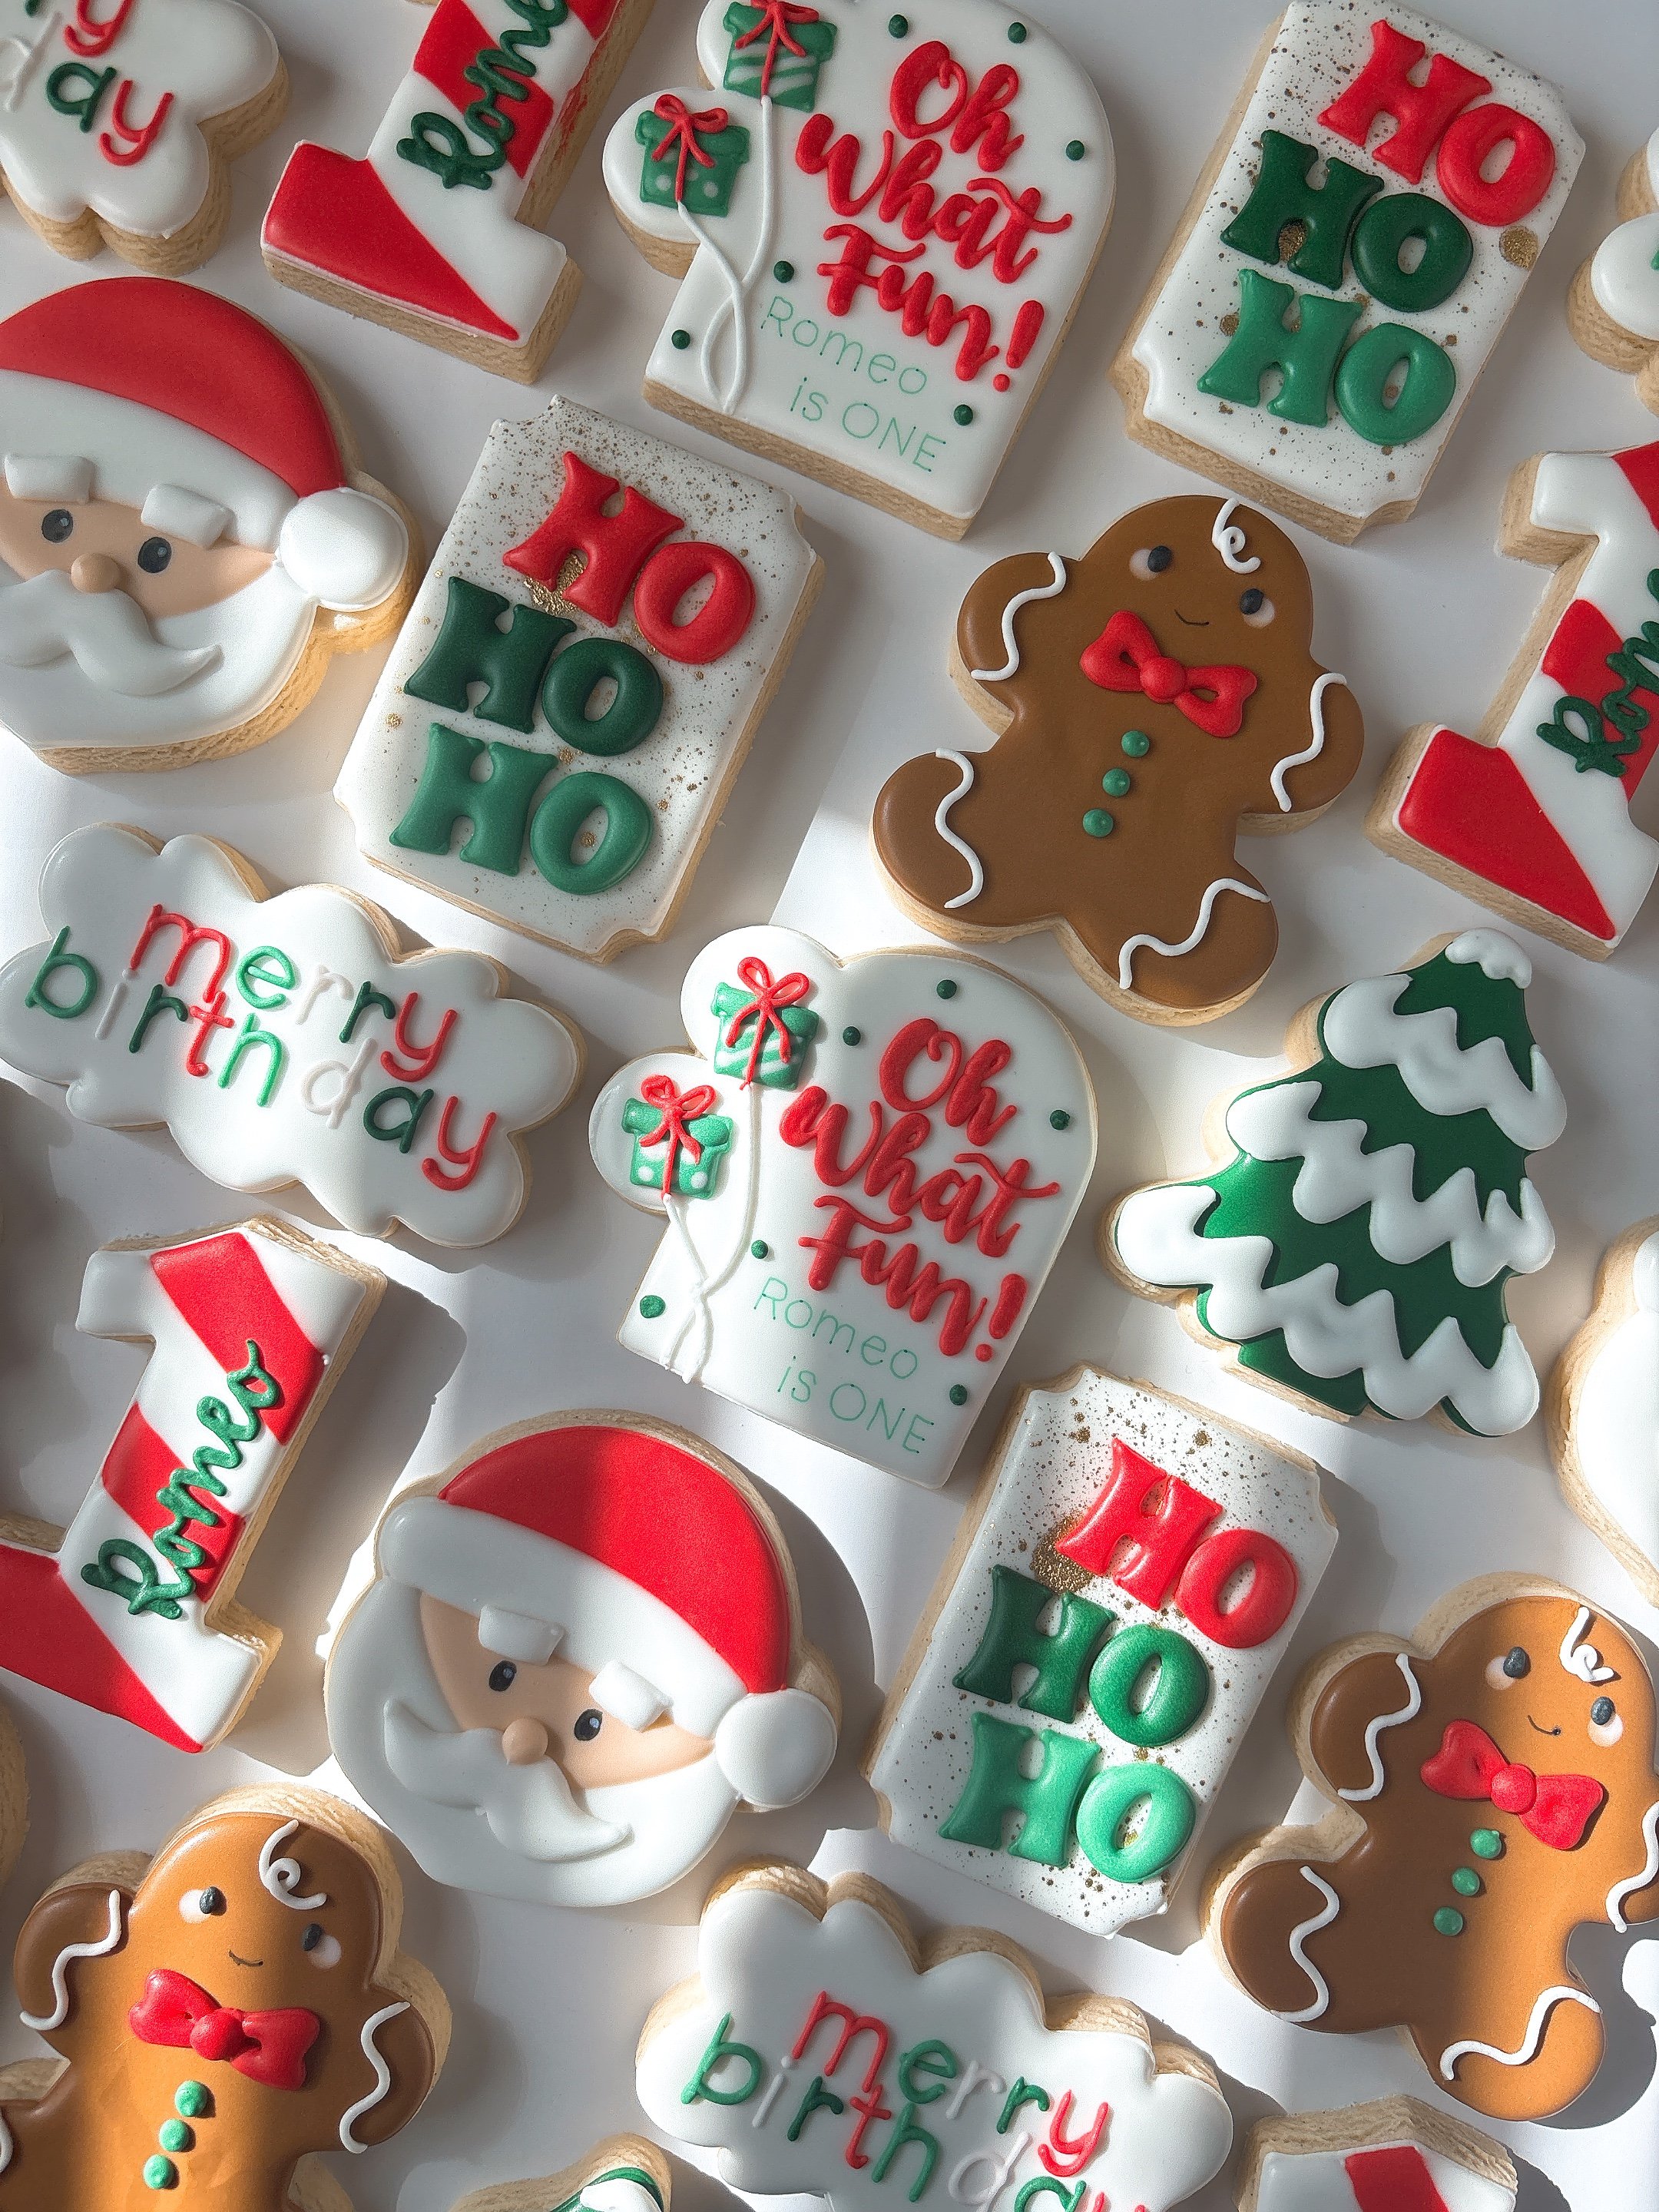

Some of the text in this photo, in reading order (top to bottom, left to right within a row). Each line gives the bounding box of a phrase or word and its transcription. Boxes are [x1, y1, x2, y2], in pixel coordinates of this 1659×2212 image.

[889, 41, 1025, 172] Oh
[1317, 19, 1557, 227] HO
[796, 114, 1073, 283] What
[1219, 129, 1474, 313] HO
[760, 295, 927, 395] Romeo
[817, 224, 1045, 392] Fun!
[1197, 269, 1457, 446] HO
[789, 376, 947, 473] is ONE
[502, 451, 757, 665] HO
[404, 576, 665, 757] HO
[389, 722, 654, 896] HO
[130, 903, 458, 1083] merry
[879, 1018, 1018, 1147] Oh
[779, 1085, 1061, 1258] What
[753, 1277, 919, 1380] Romeo
[798, 1195, 1028, 1363] Fun!
[777, 1355, 935, 1454] is ONE
[1055, 1436, 1299, 1649] HO
[952, 1564, 1210, 1749] HO
[937, 1710, 1197, 1886] HO
[793, 1990, 1109, 2177] merry
